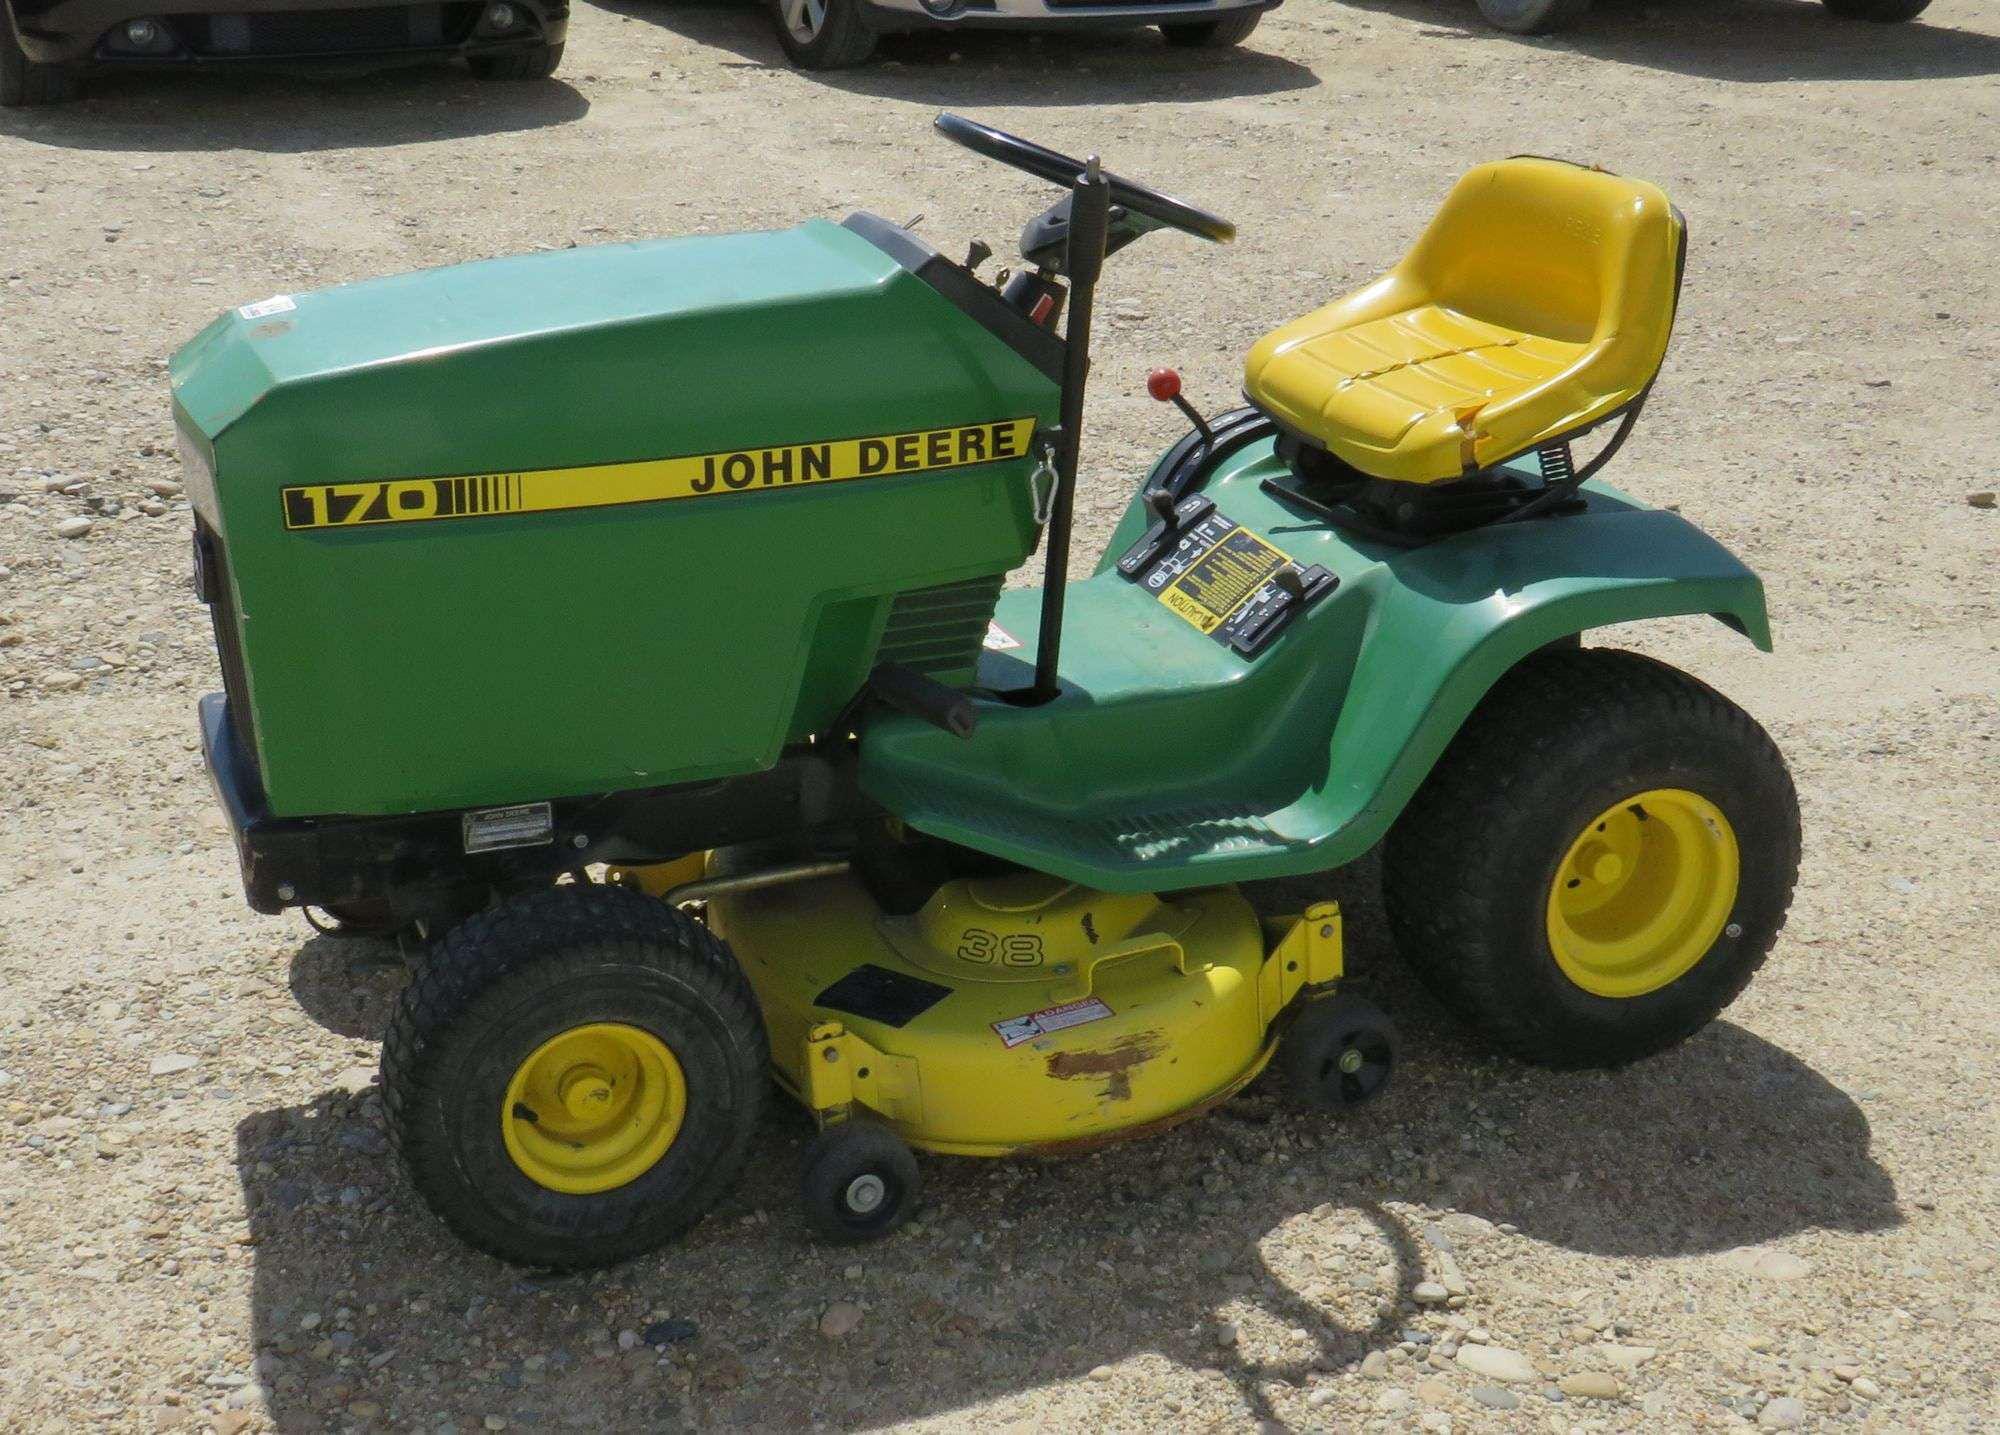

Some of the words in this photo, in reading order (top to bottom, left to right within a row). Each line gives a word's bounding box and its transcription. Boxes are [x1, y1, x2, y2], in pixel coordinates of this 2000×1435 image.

[690, 445, 831, 493] JOHN
[859, 423, 1016, 474] DEERE
[303, 481, 438, 526] 170
[1167, 592, 1205, 624] CAUTION
[957, 928, 1044, 967] 38
